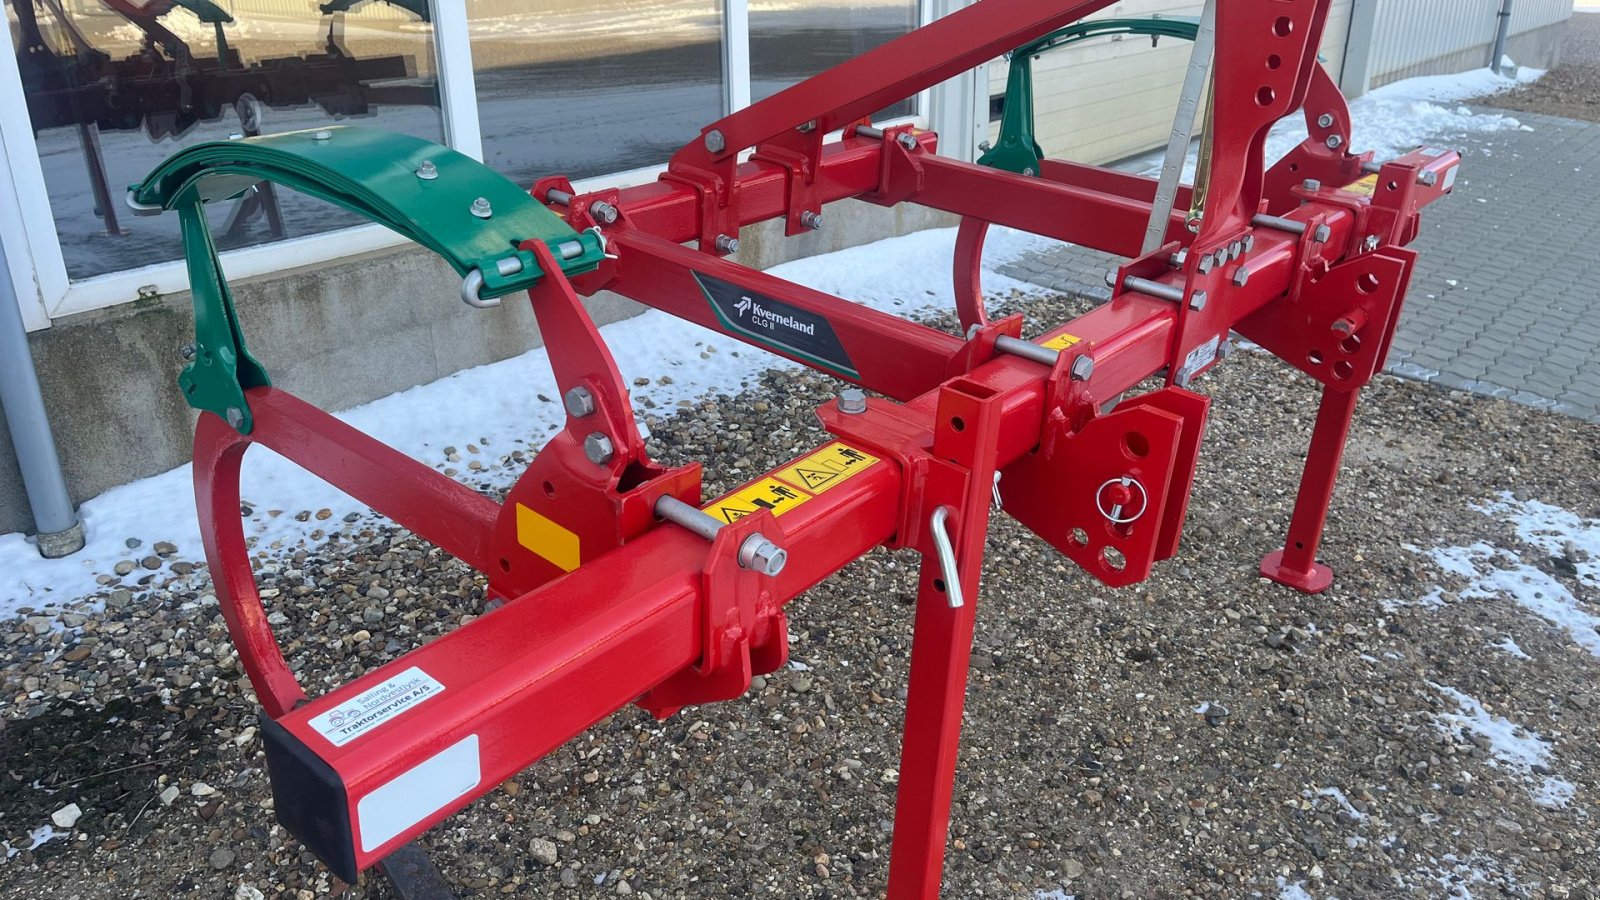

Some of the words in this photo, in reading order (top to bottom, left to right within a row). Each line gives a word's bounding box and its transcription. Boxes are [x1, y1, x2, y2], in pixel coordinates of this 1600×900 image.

[752, 315, 768, 328] CLG
[753, 303, 814, 335] Kverneland
[357, 686, 390, 705] Salling
[363, 677, 422, 709] Nordvestjysk
[340, 695, 412, 735] Traktorservice
[413, 685, 431, 697] A/S
